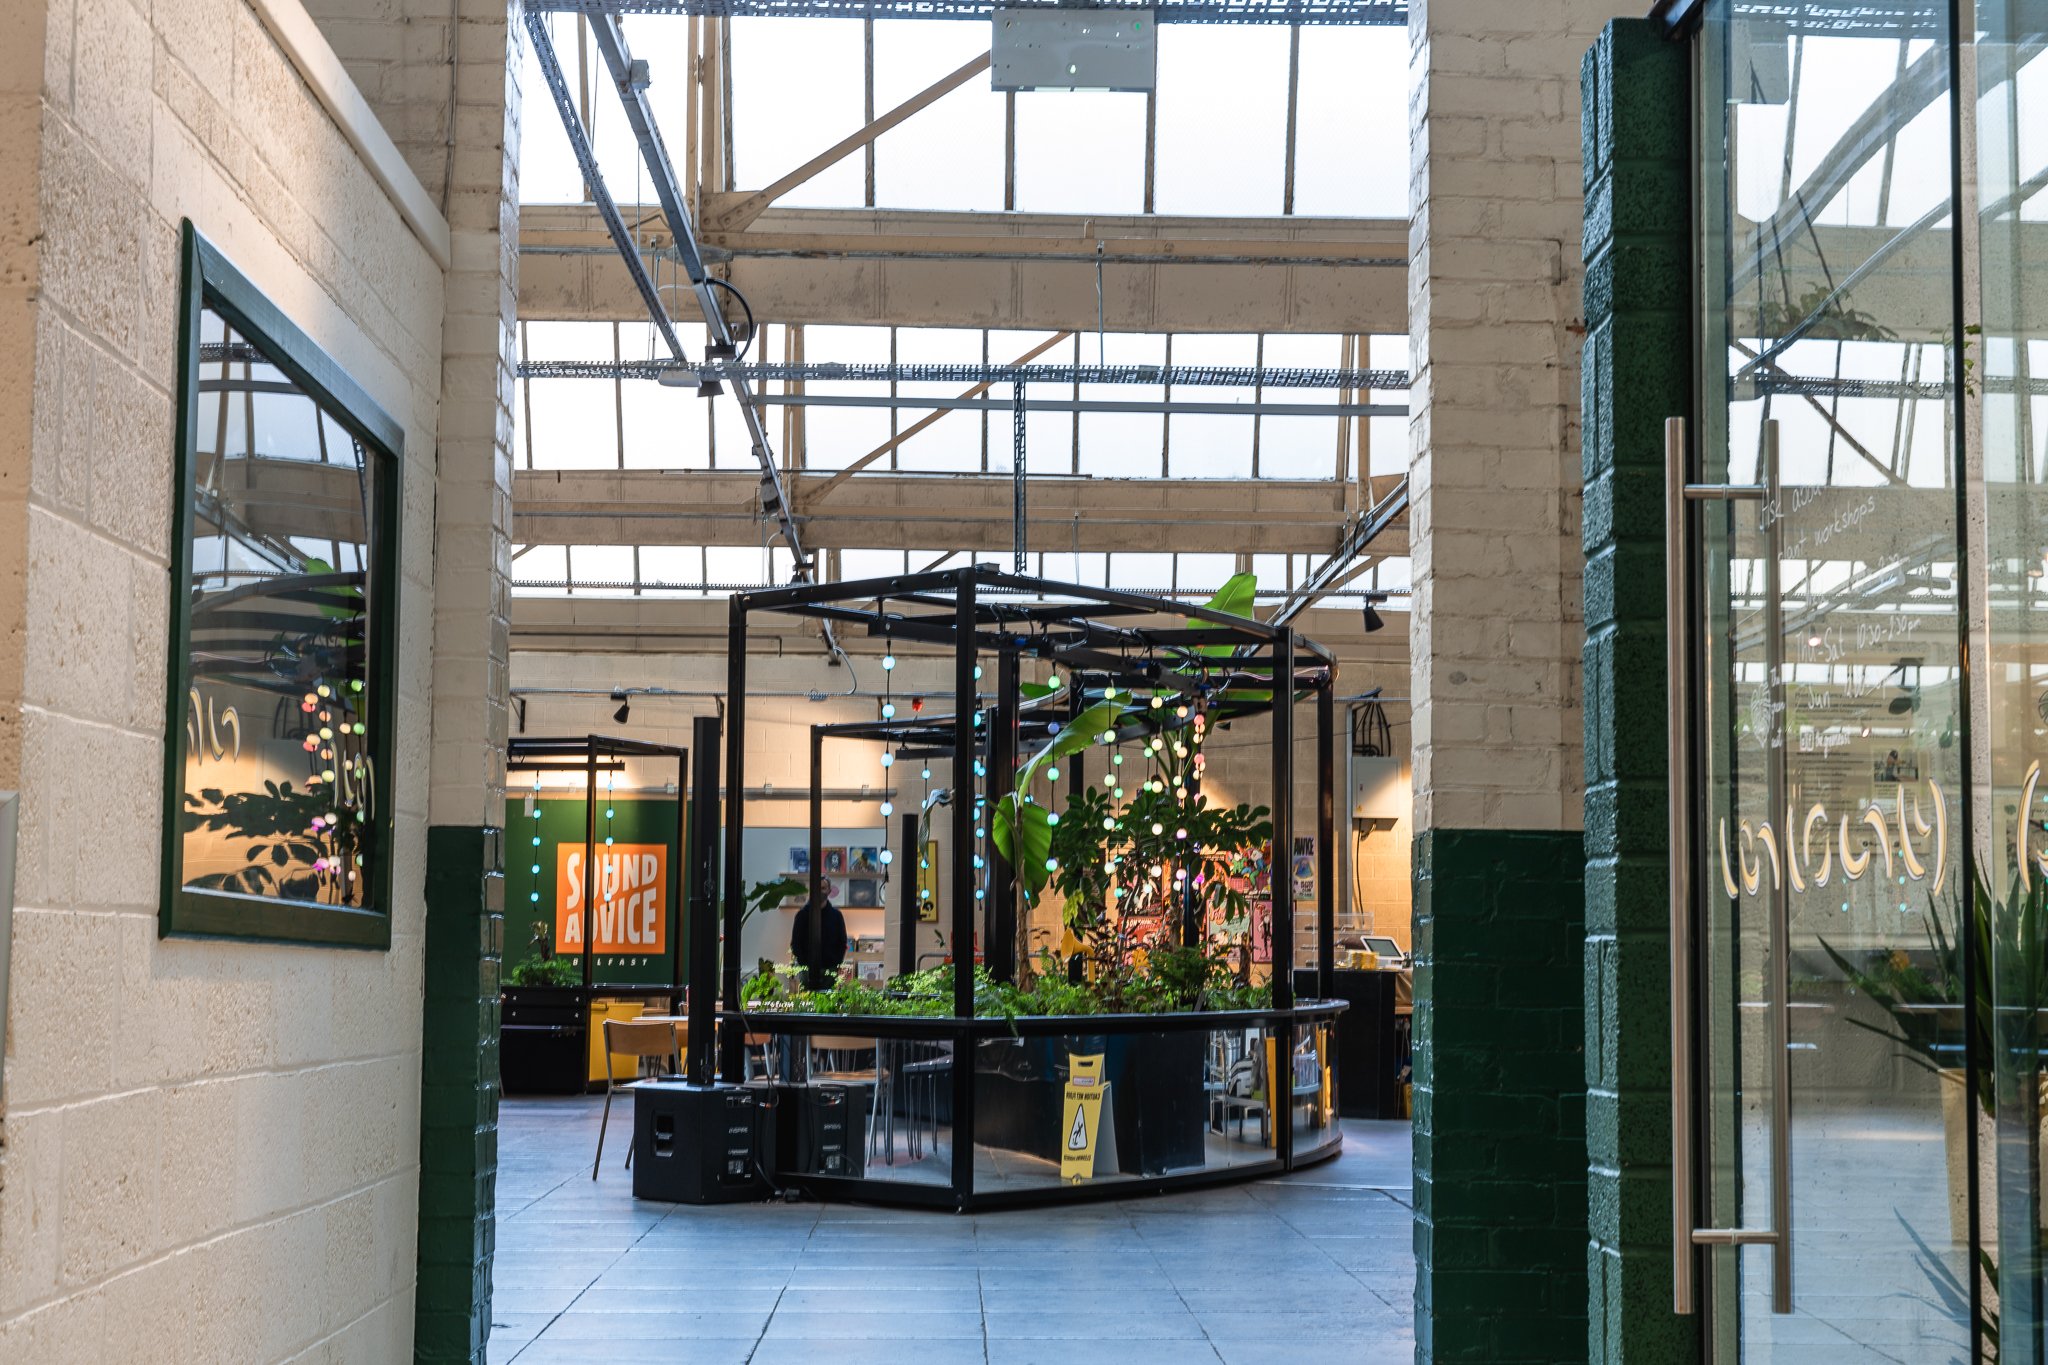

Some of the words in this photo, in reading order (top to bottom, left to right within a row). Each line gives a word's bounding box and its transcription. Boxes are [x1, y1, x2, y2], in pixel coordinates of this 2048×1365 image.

[1814, 495, 1876, 547] workshops
[566, 852, 658, 911] SOUND
[572, 957, 648, 967] BLFAST
